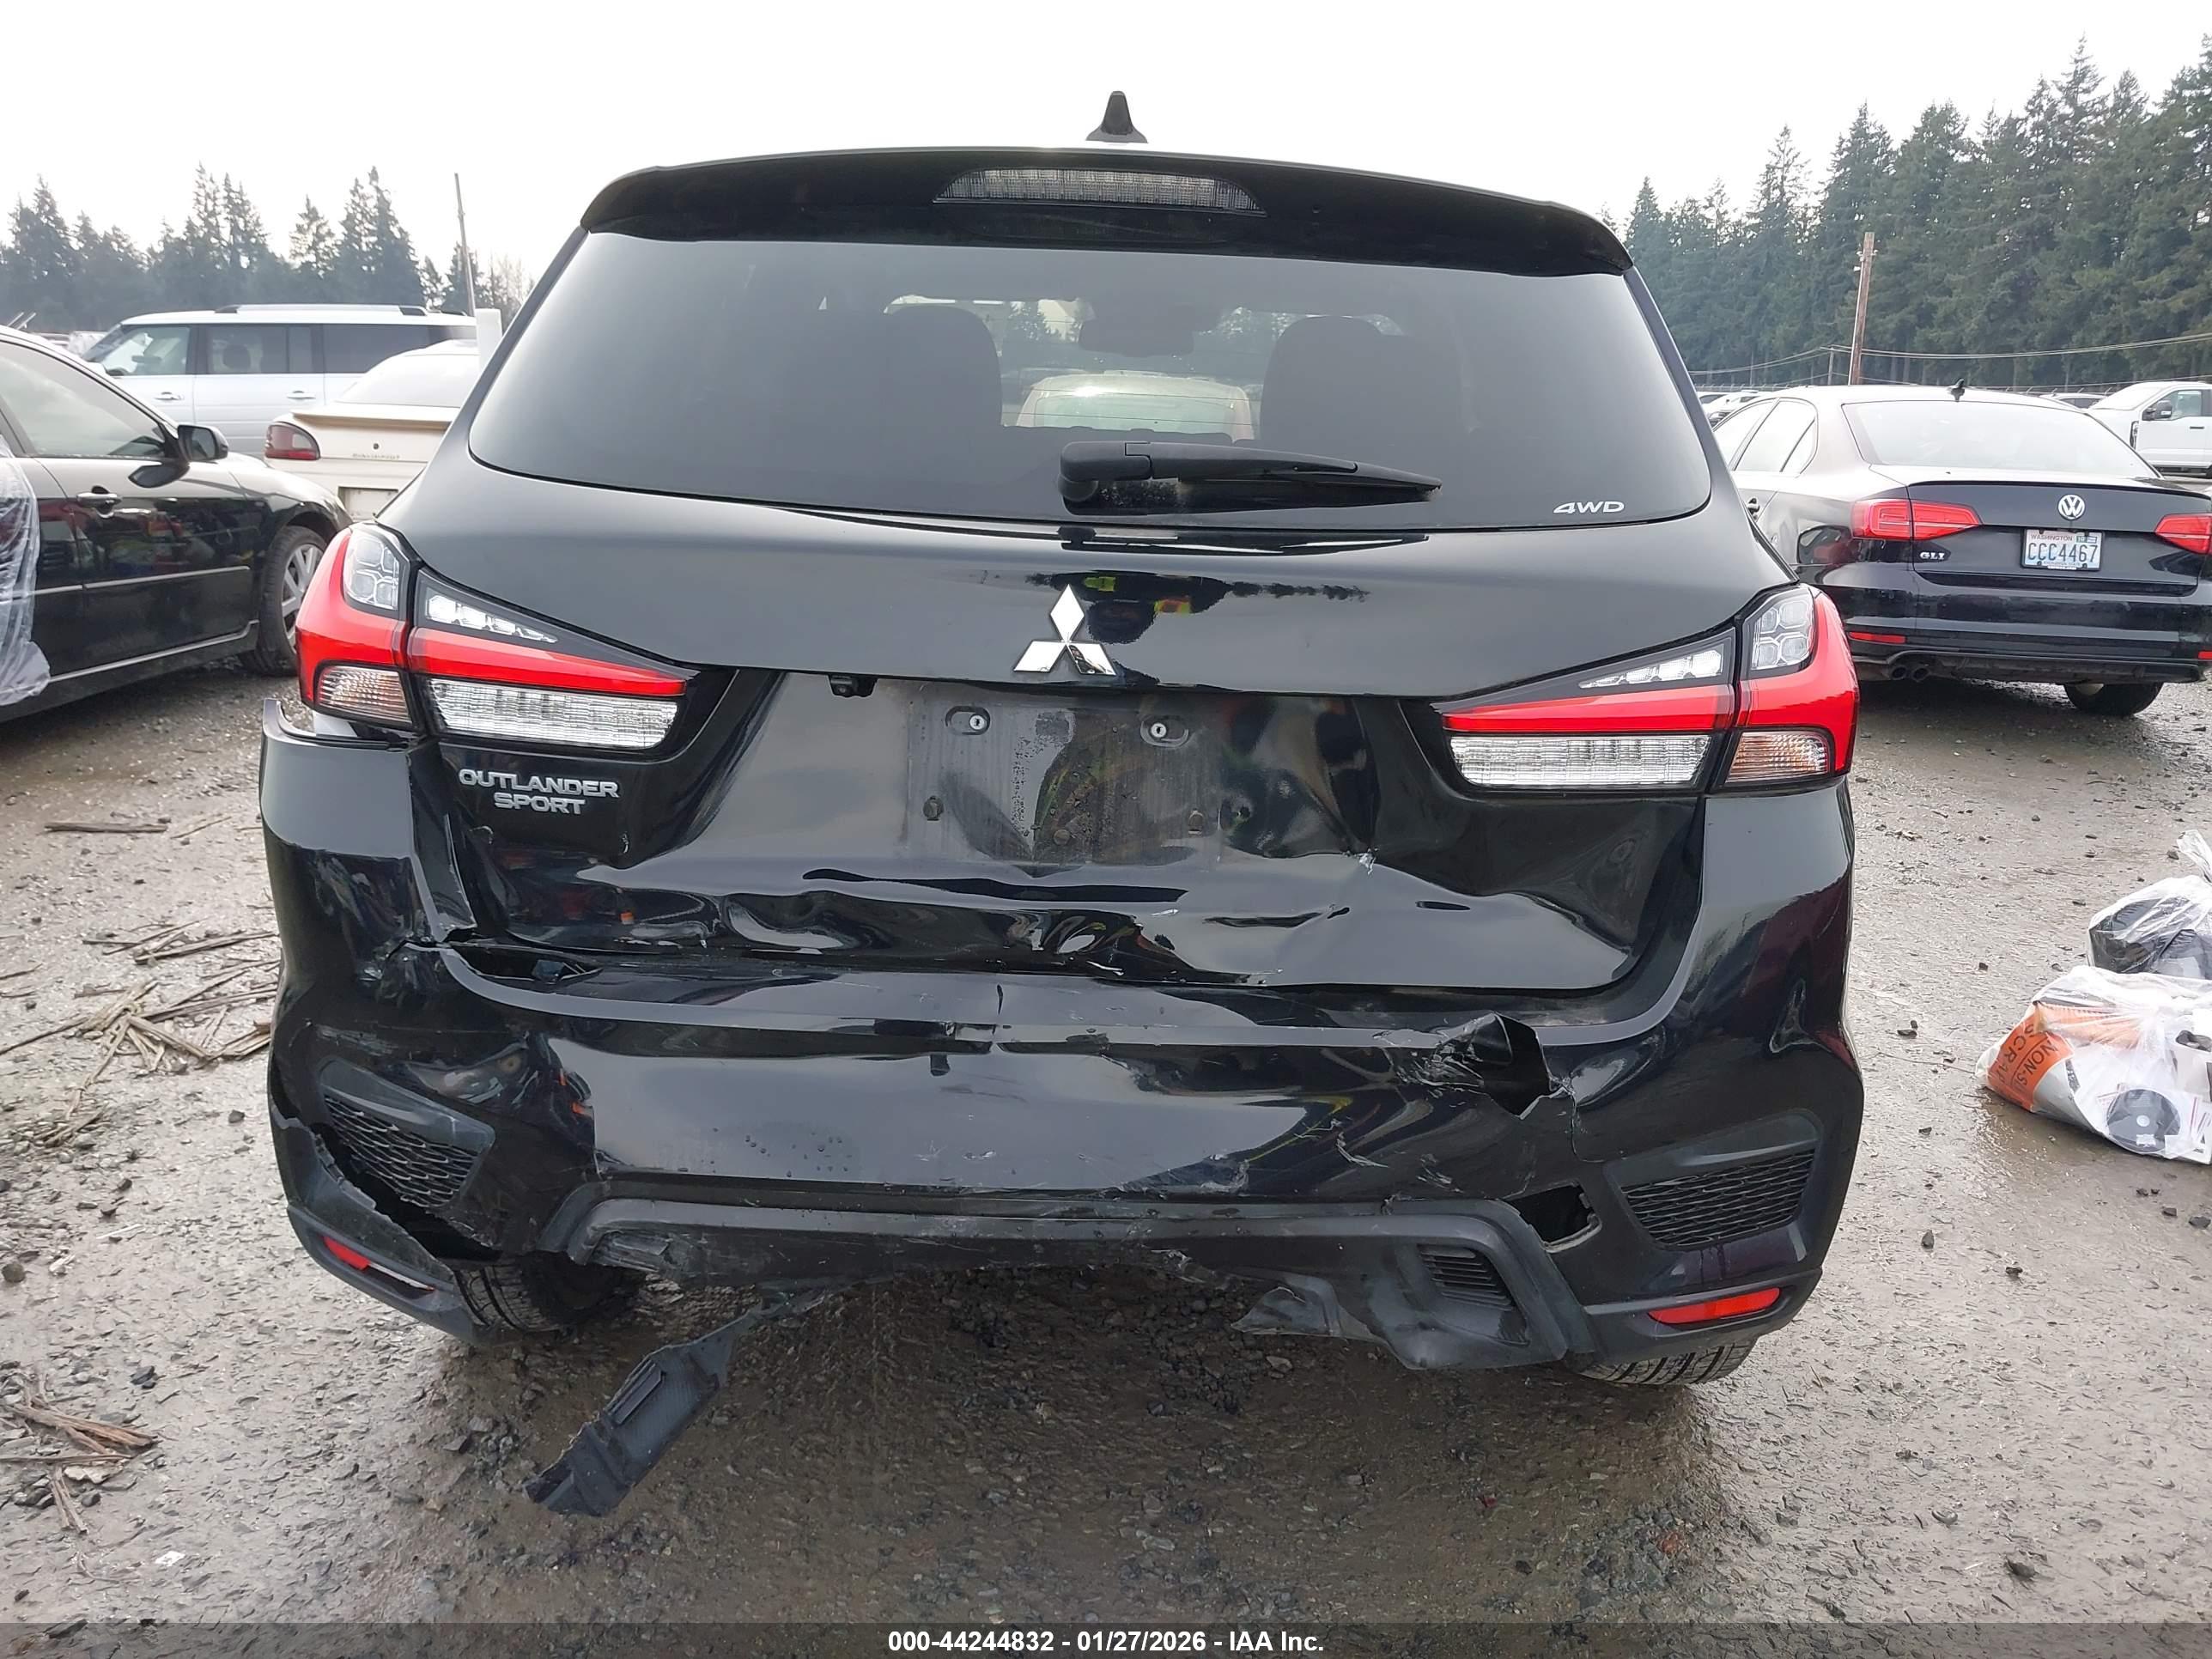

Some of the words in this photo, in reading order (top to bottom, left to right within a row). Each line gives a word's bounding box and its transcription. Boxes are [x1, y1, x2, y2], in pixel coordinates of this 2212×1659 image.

[1553, 501, 1625, 514] 4WD
[1919, 551, 1945, 560] GLI
[2027, 542, 2098, 563] CCC4467
[458, 768, 620, 799] OUTLANDER
[493, 791, 586, 815] SPORT
